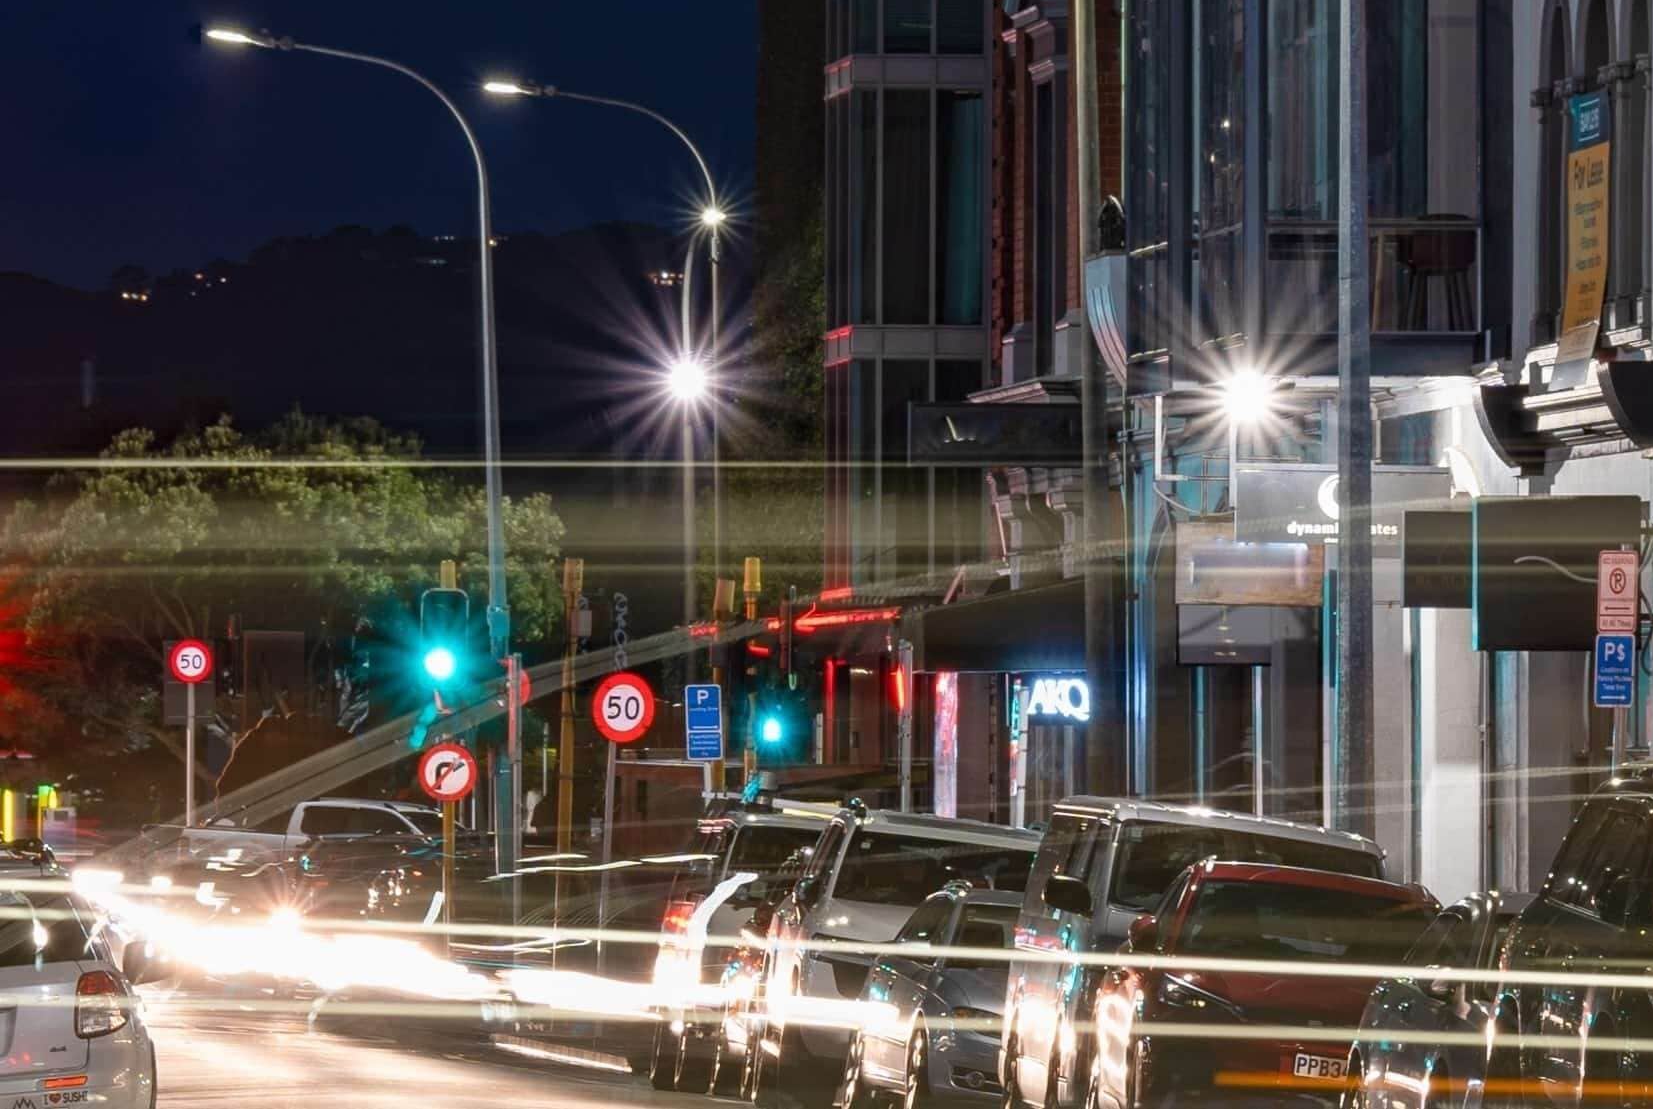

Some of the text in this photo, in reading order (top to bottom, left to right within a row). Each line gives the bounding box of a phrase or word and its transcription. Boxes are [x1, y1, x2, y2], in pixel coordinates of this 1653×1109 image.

[181, 654, 202, 669] 50
[697, 689, 709, 705] P
[607, 696, 640, 720] 50
[63, 1091, 88, 1103] SUSHI
